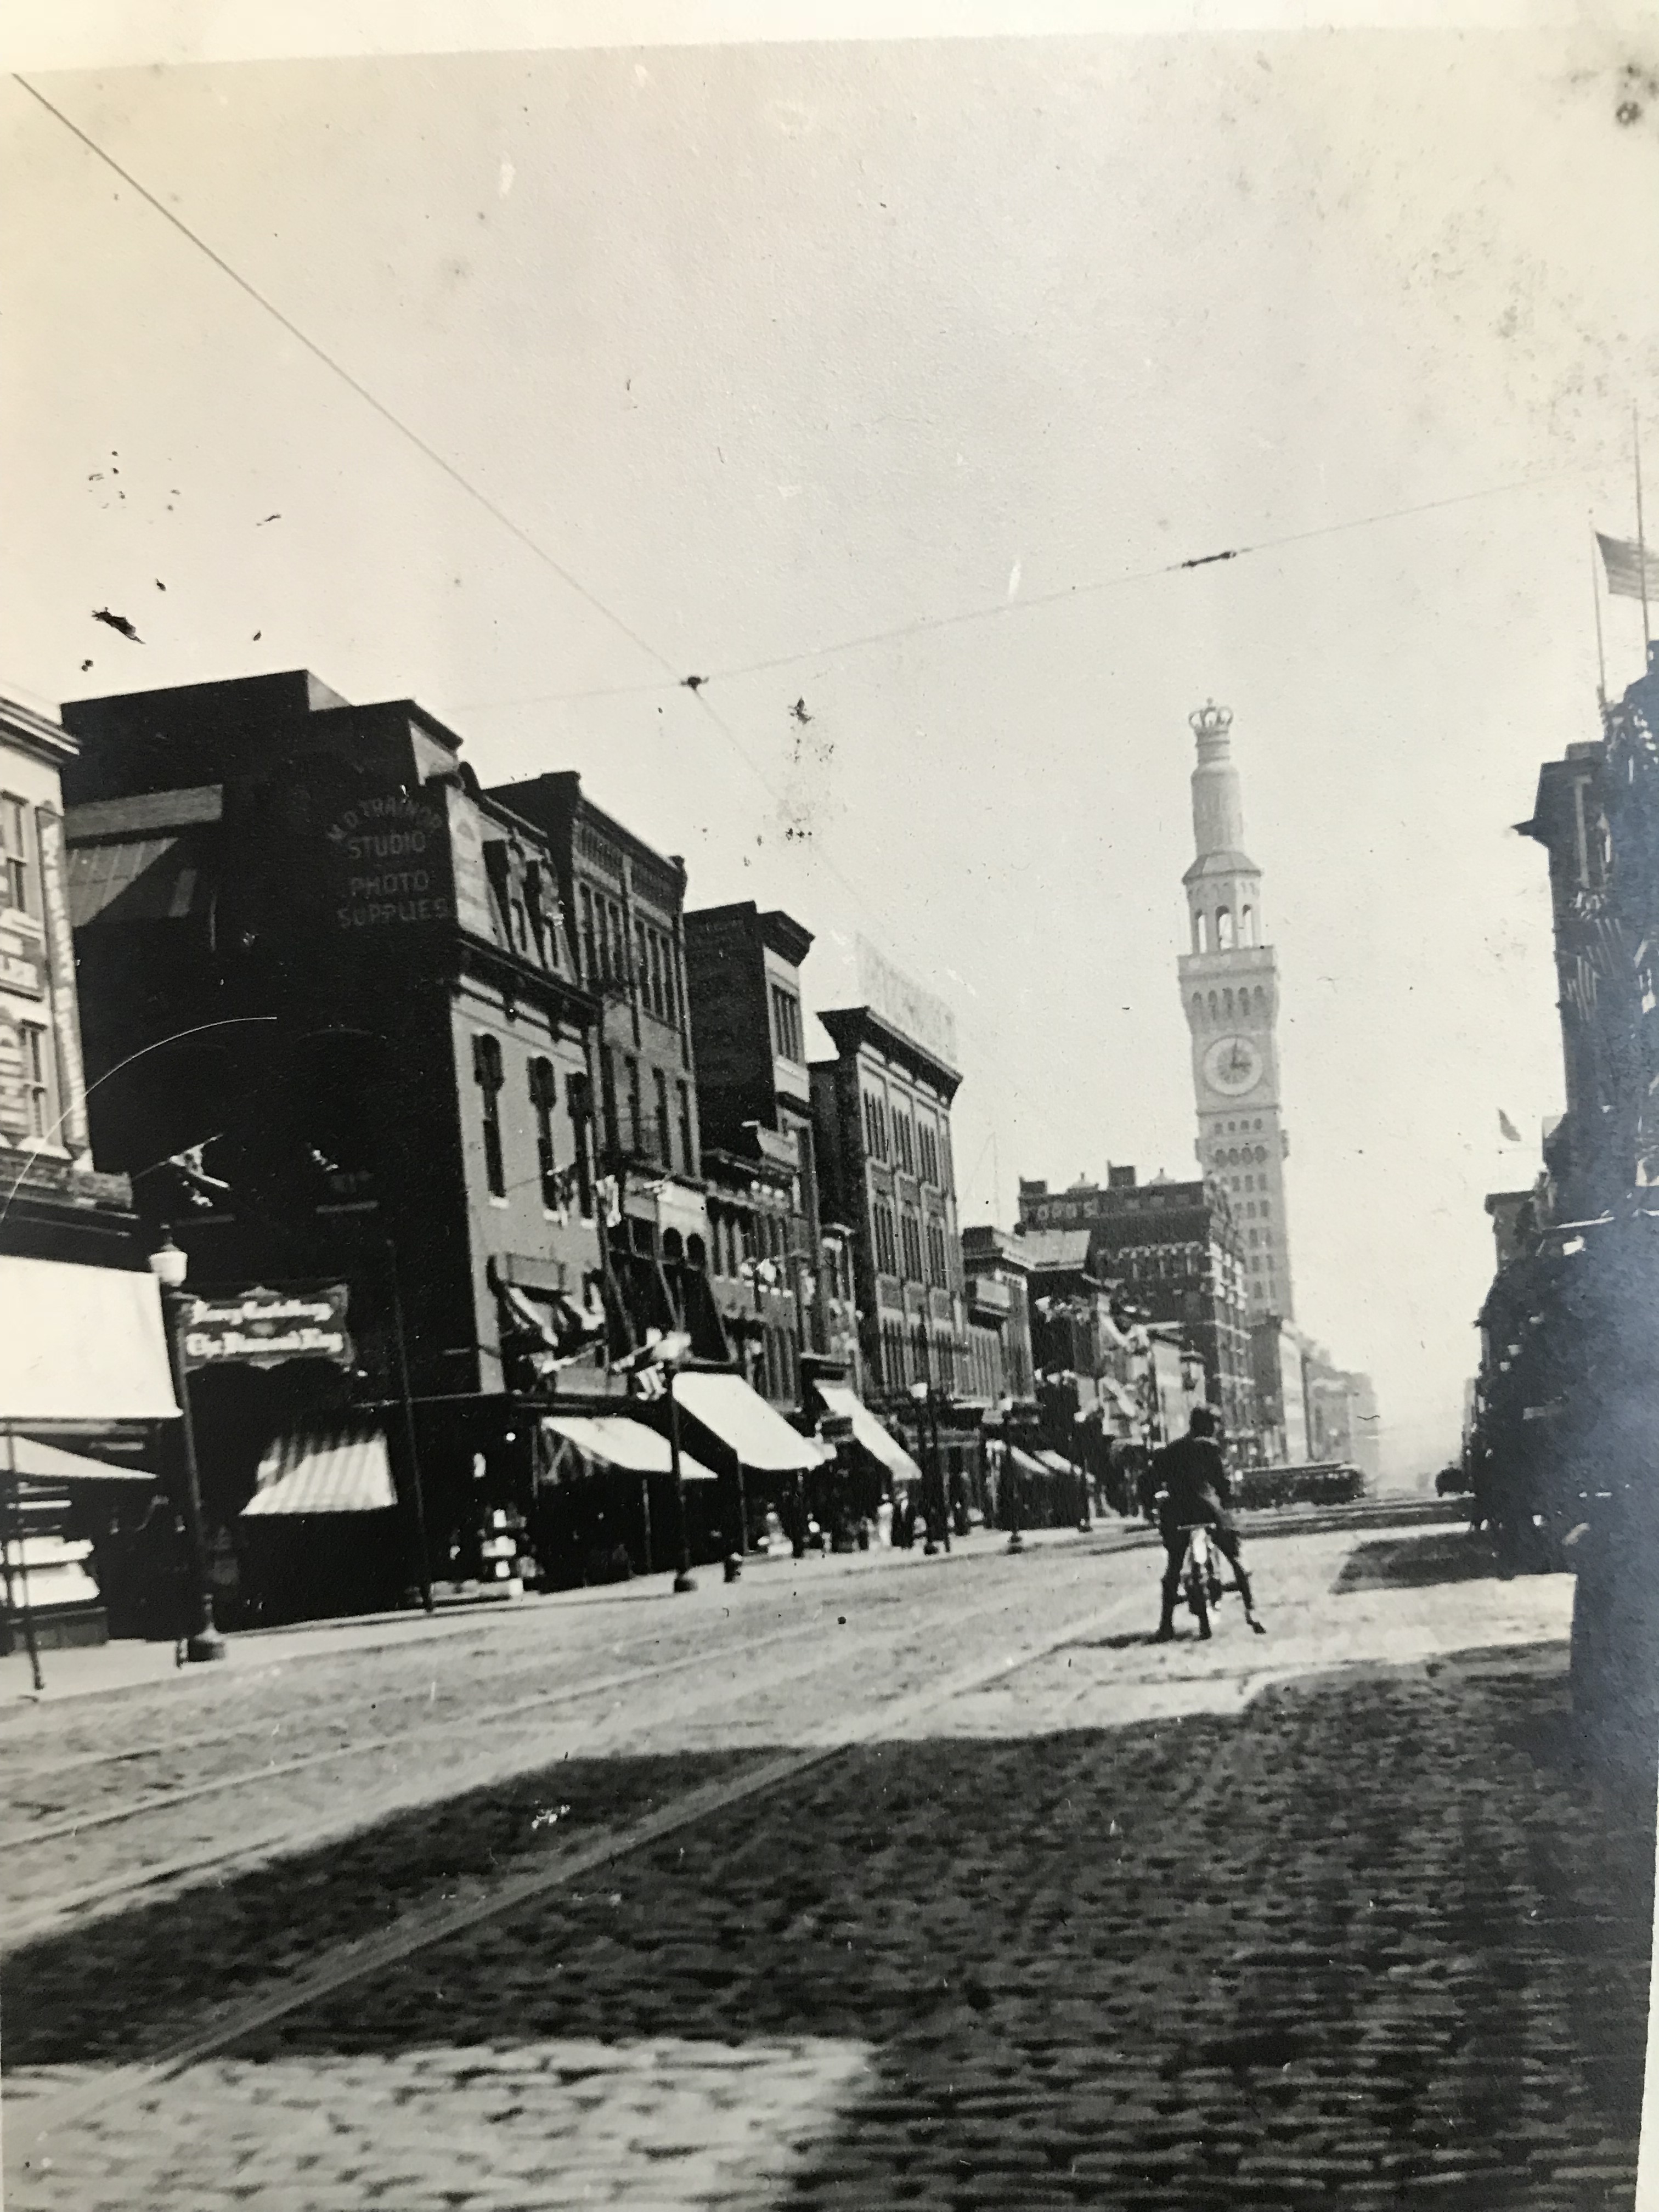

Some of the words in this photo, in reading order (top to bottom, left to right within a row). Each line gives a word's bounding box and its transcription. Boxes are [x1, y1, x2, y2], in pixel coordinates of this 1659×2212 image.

[348, 830, 426, 859] STUDIO
[350, 870, 430, 898] PHOTO
[337, 898, 449, 928] SUPPLIES
